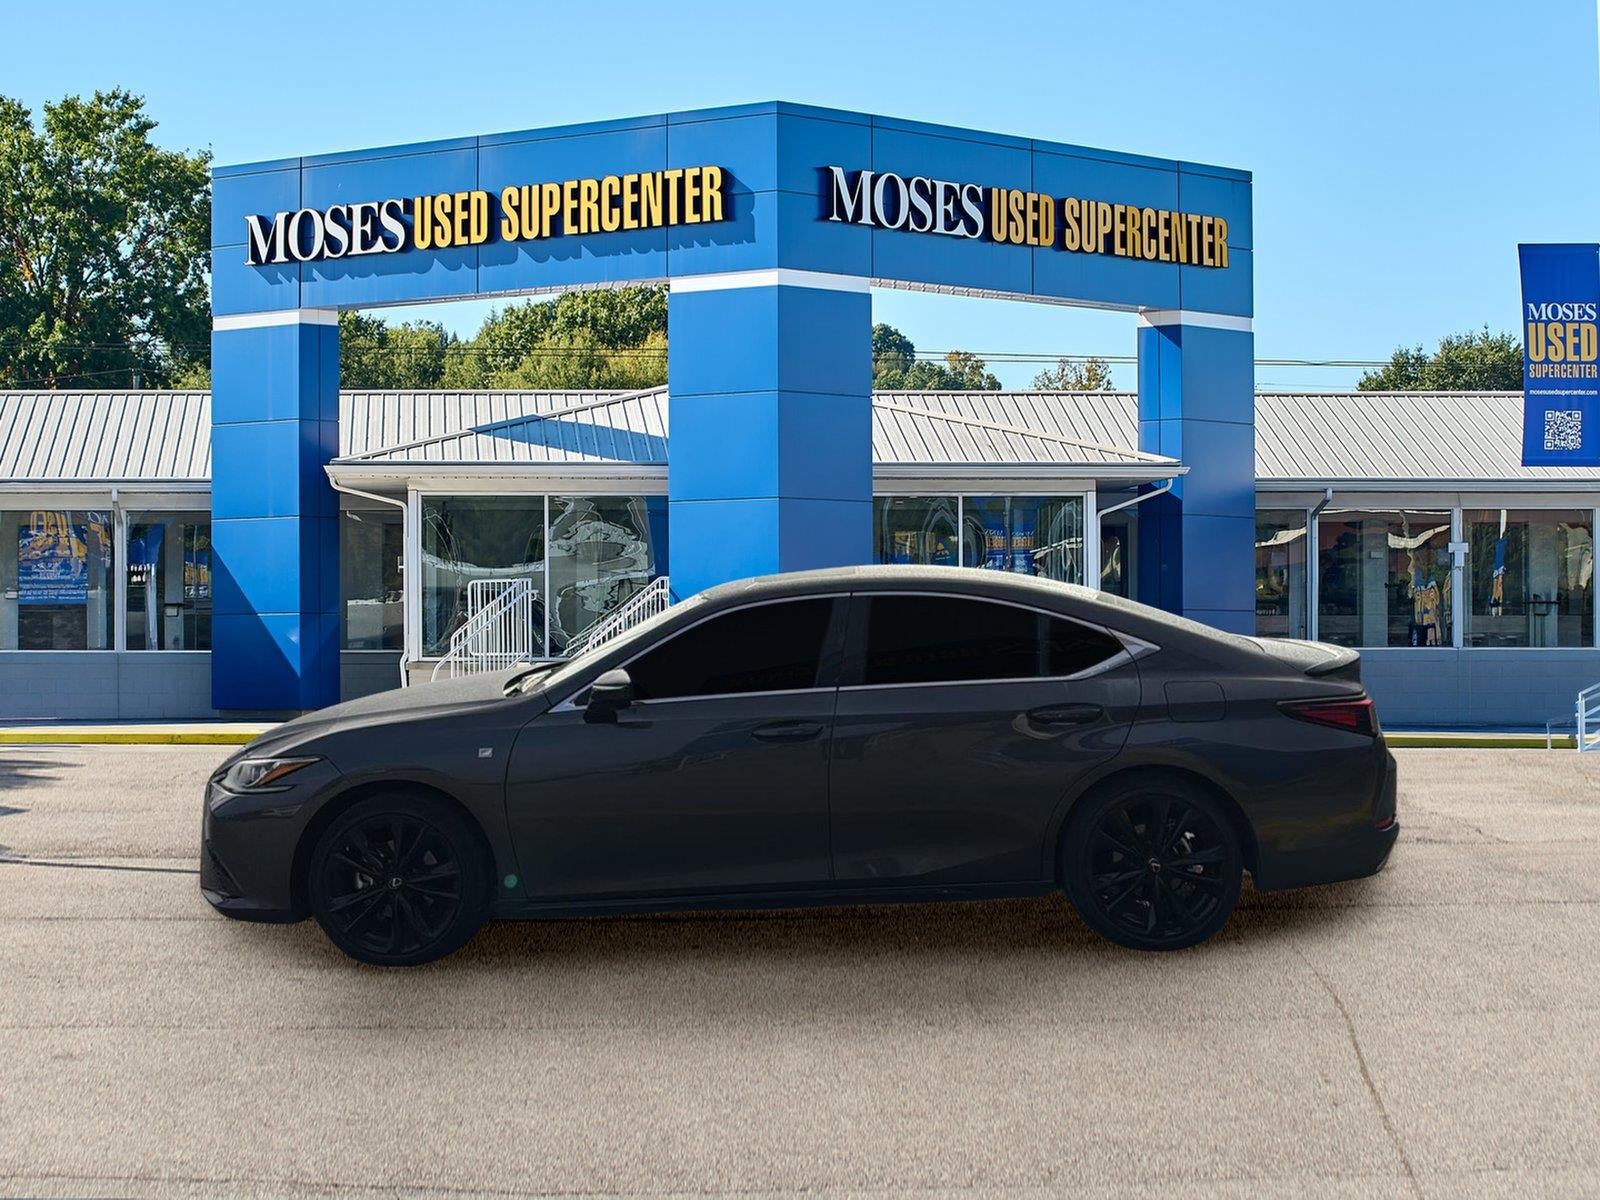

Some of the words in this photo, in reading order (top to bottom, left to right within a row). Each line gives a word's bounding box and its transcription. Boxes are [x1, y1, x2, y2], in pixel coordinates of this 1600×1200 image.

[244, 199, 406, 266] MOSES
[413, 190, 489, 250] USED
[501, 165, 724, 242] SUPERCENTER
[828, 165, 985, 239] MOSES
[991, 187, 1056, 248] USED
[1065, 197, 1230, 269] SUPERCENTER
[1527, 302, 1597, 321] MOSES
[1528, 322, 1598, 362] USED
[1529, 364, 1598, 379] SUPERCENTER
